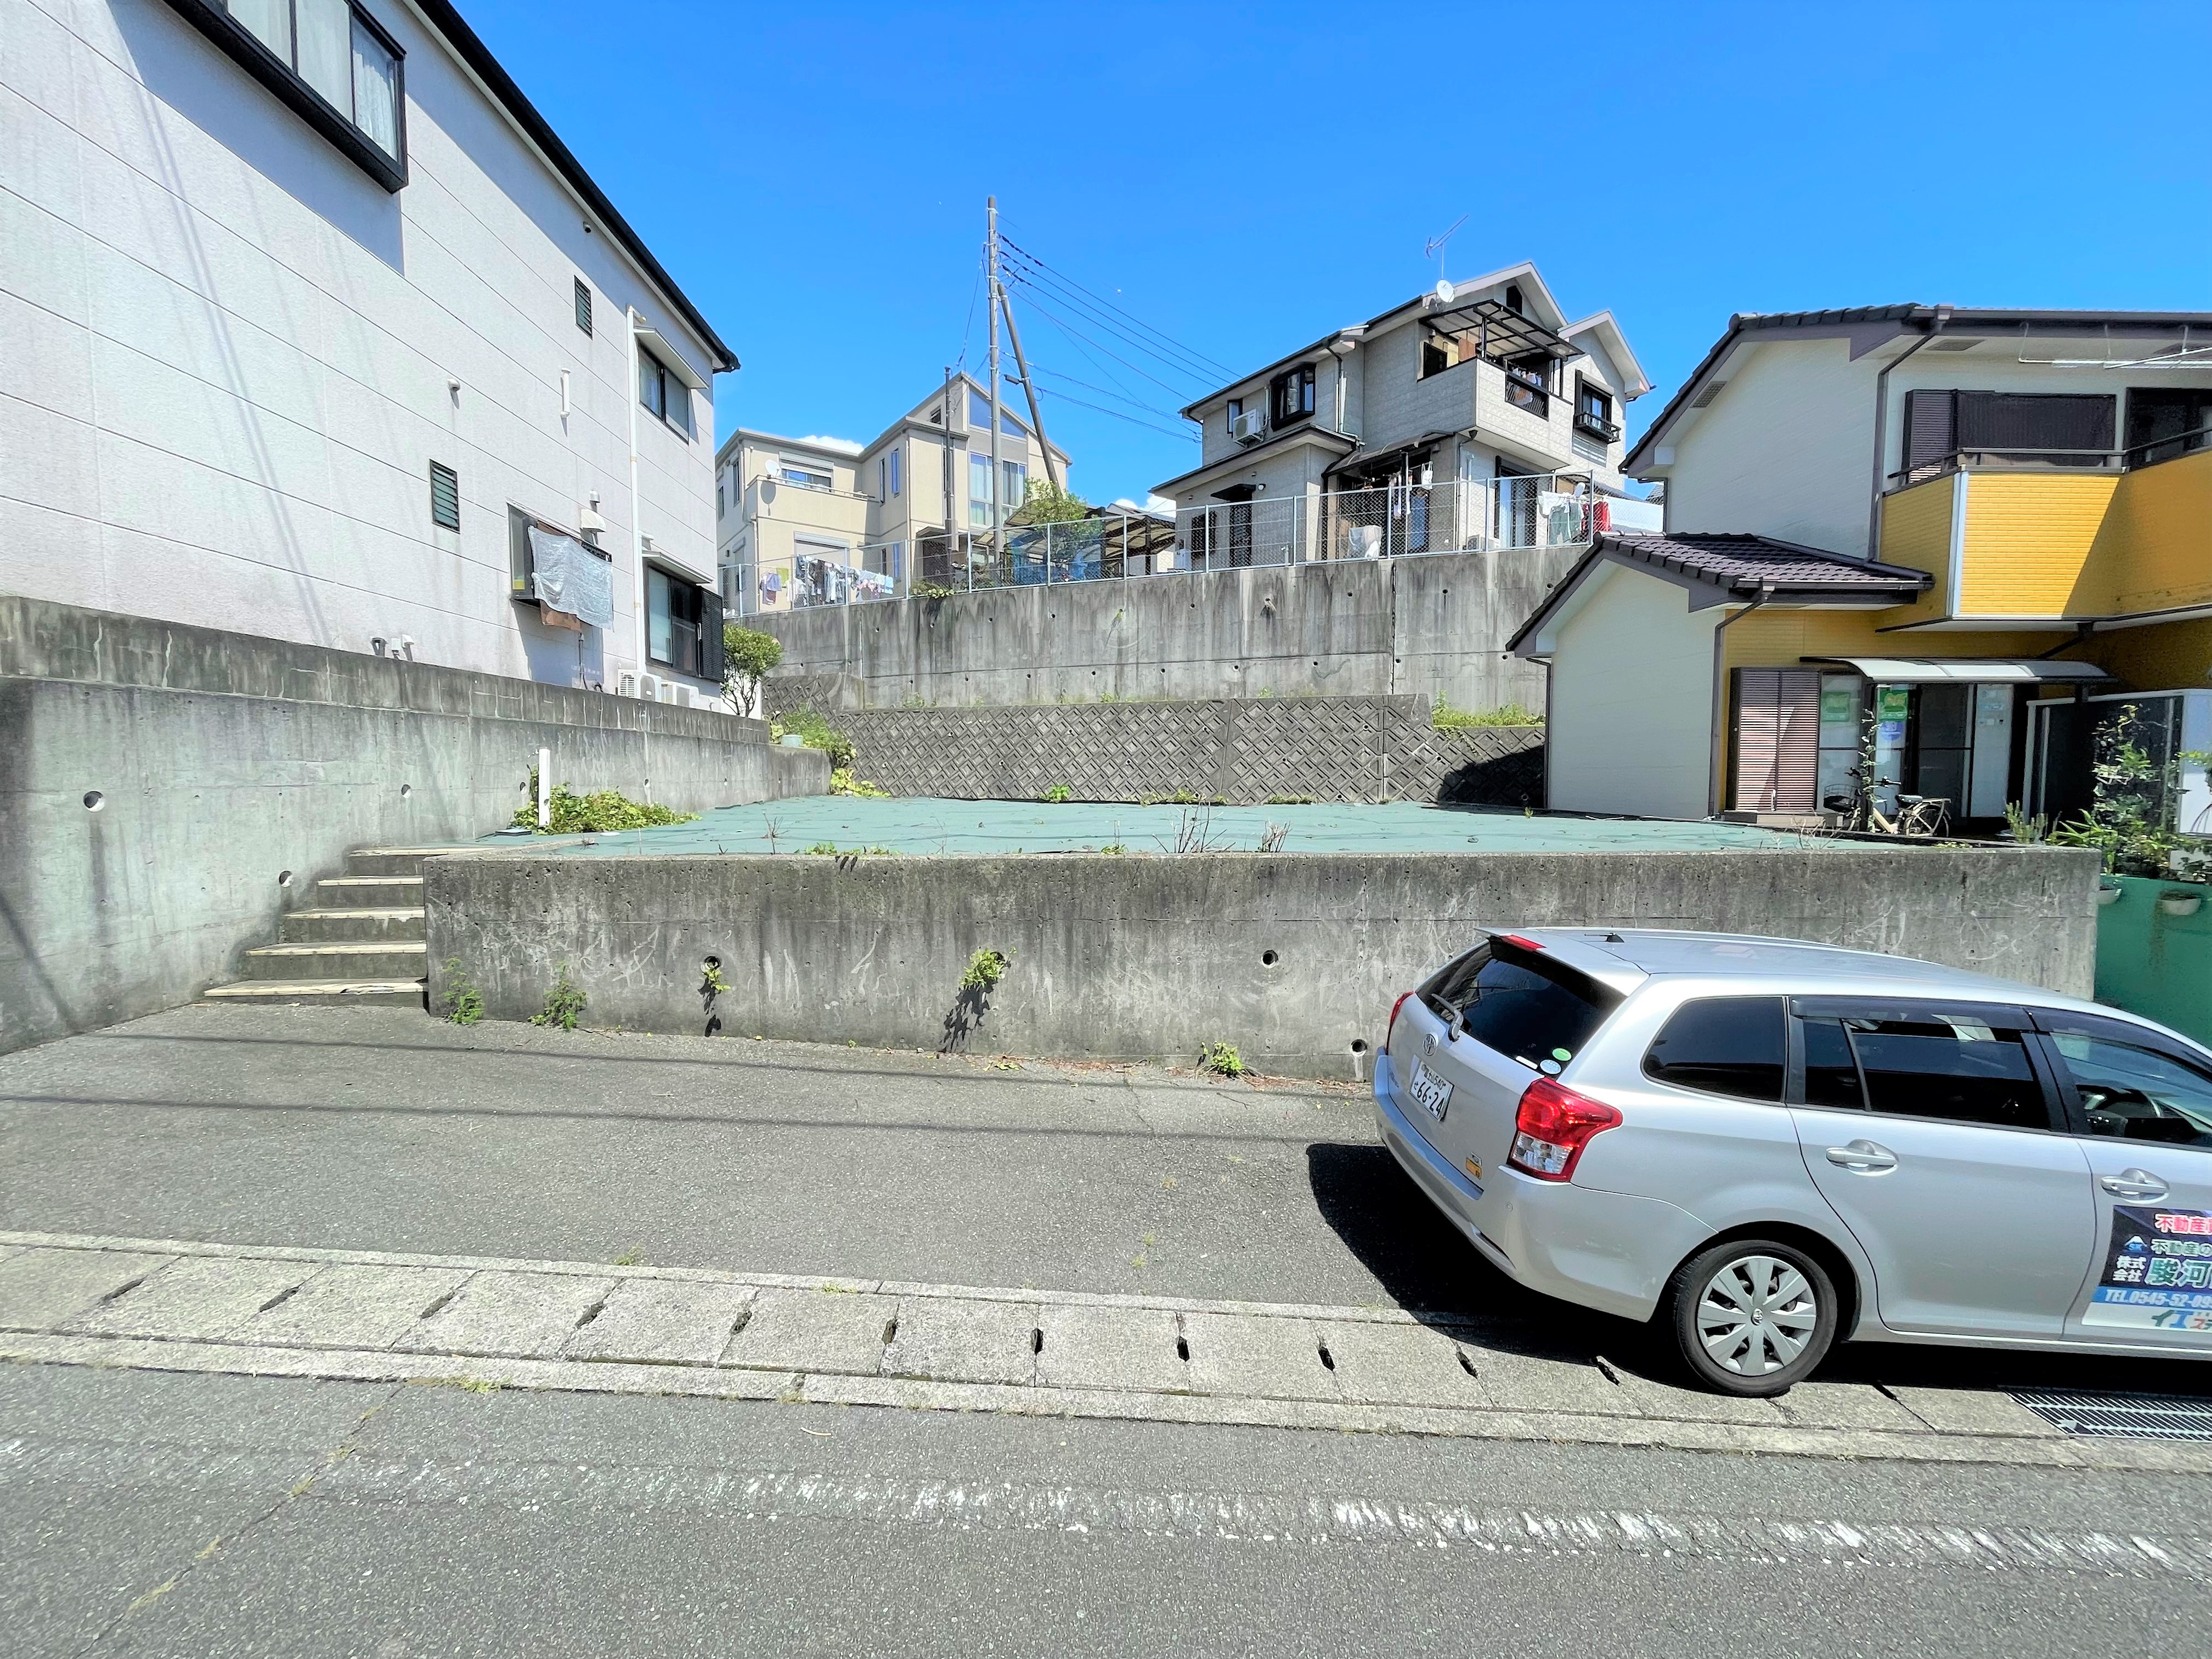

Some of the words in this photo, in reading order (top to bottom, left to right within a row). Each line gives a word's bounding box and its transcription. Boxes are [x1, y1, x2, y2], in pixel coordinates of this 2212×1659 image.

[2154, 1214, 2212, 1235] 不動産
[2144, 1257, 2212, 1289] 駿河
